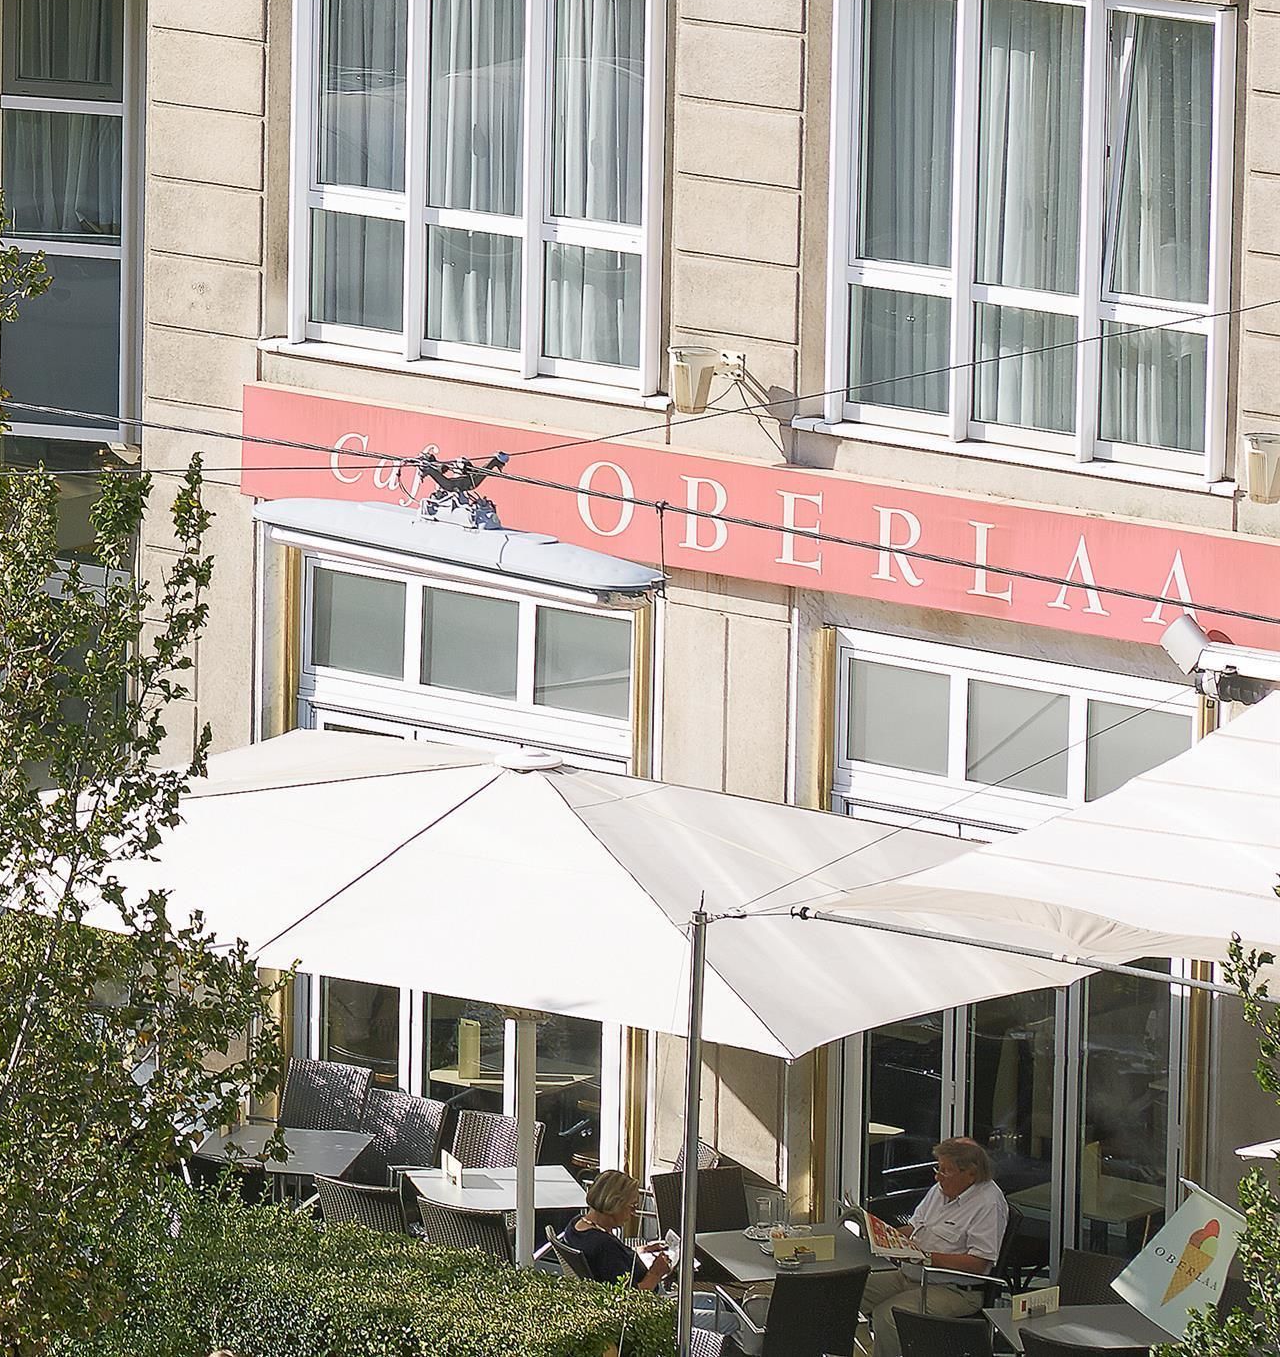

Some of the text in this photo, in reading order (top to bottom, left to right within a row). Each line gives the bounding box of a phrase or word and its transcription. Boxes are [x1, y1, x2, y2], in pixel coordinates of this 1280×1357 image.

[330, 432, 1207, 633] Caf OBERLAA
[1154, 1246, 1218, 1291] OBERLAA
